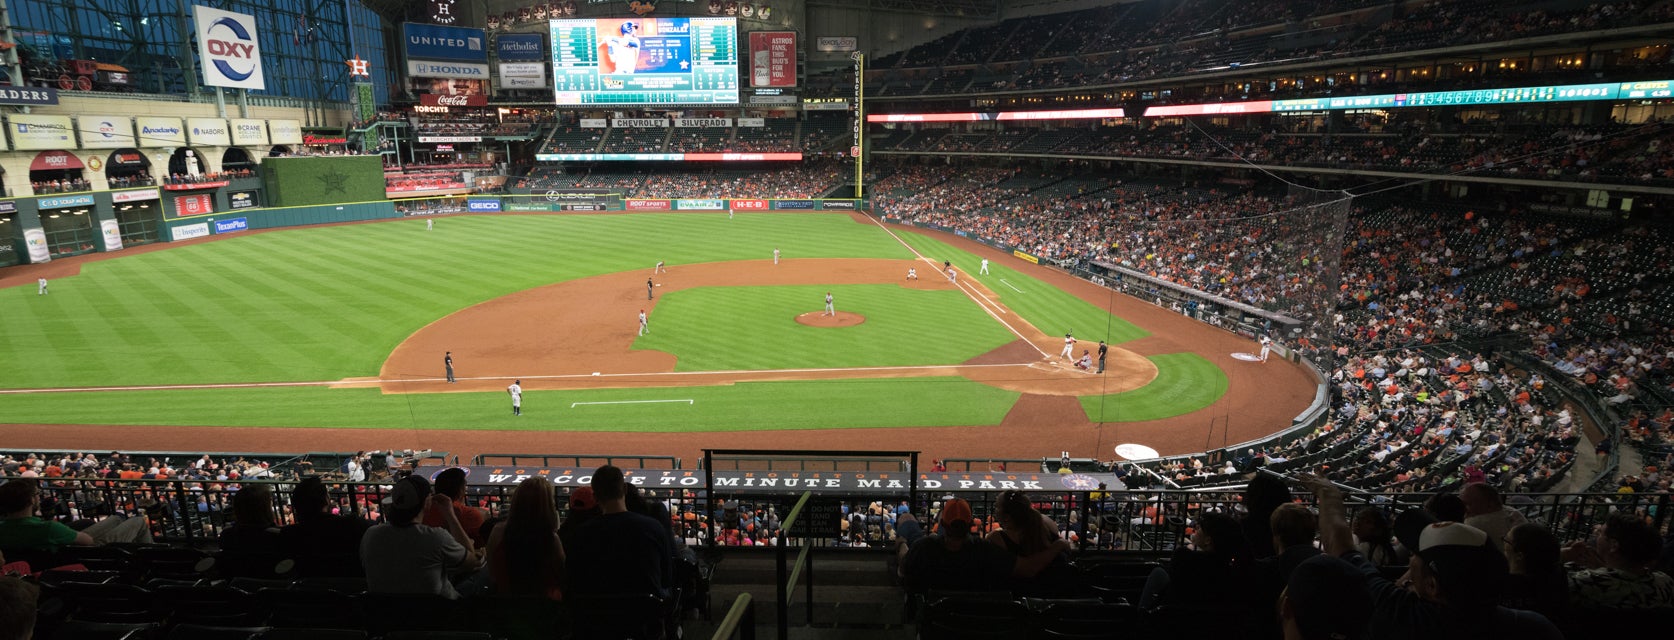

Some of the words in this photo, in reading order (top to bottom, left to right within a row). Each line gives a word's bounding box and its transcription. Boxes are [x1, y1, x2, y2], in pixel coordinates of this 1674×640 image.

[411, 36, 465, 47] UNITED
[502, 42, 538, 50] Methodist
[207, 39, 254, 59] OXY
[353, 60, 370, 76] H
[430, 65, 482, 74] HONDA
[1428, 94, 1434, 104] 3
[1436, 94, 1442, 103] 4
[1446, 94, 1453, 103] 5
[1456, 93, 1462, 103] 6
[1465, 93, 1472, 102] 7
[1475, 92, 1481, 102] 8
[1485, 92, 1492, 101] 9
[617, 119, 664, 127] CHEVROLET
[682, 119, 726, 127] SILVERADO
[304, 136, 346, 144] Budweiser
[217, 221, 246, 230] TexanPlus
[660, 476, 699, 485] TO
[714, 477, 841, 487] MINUTE
[958, 480, 1043, 490] PARK
